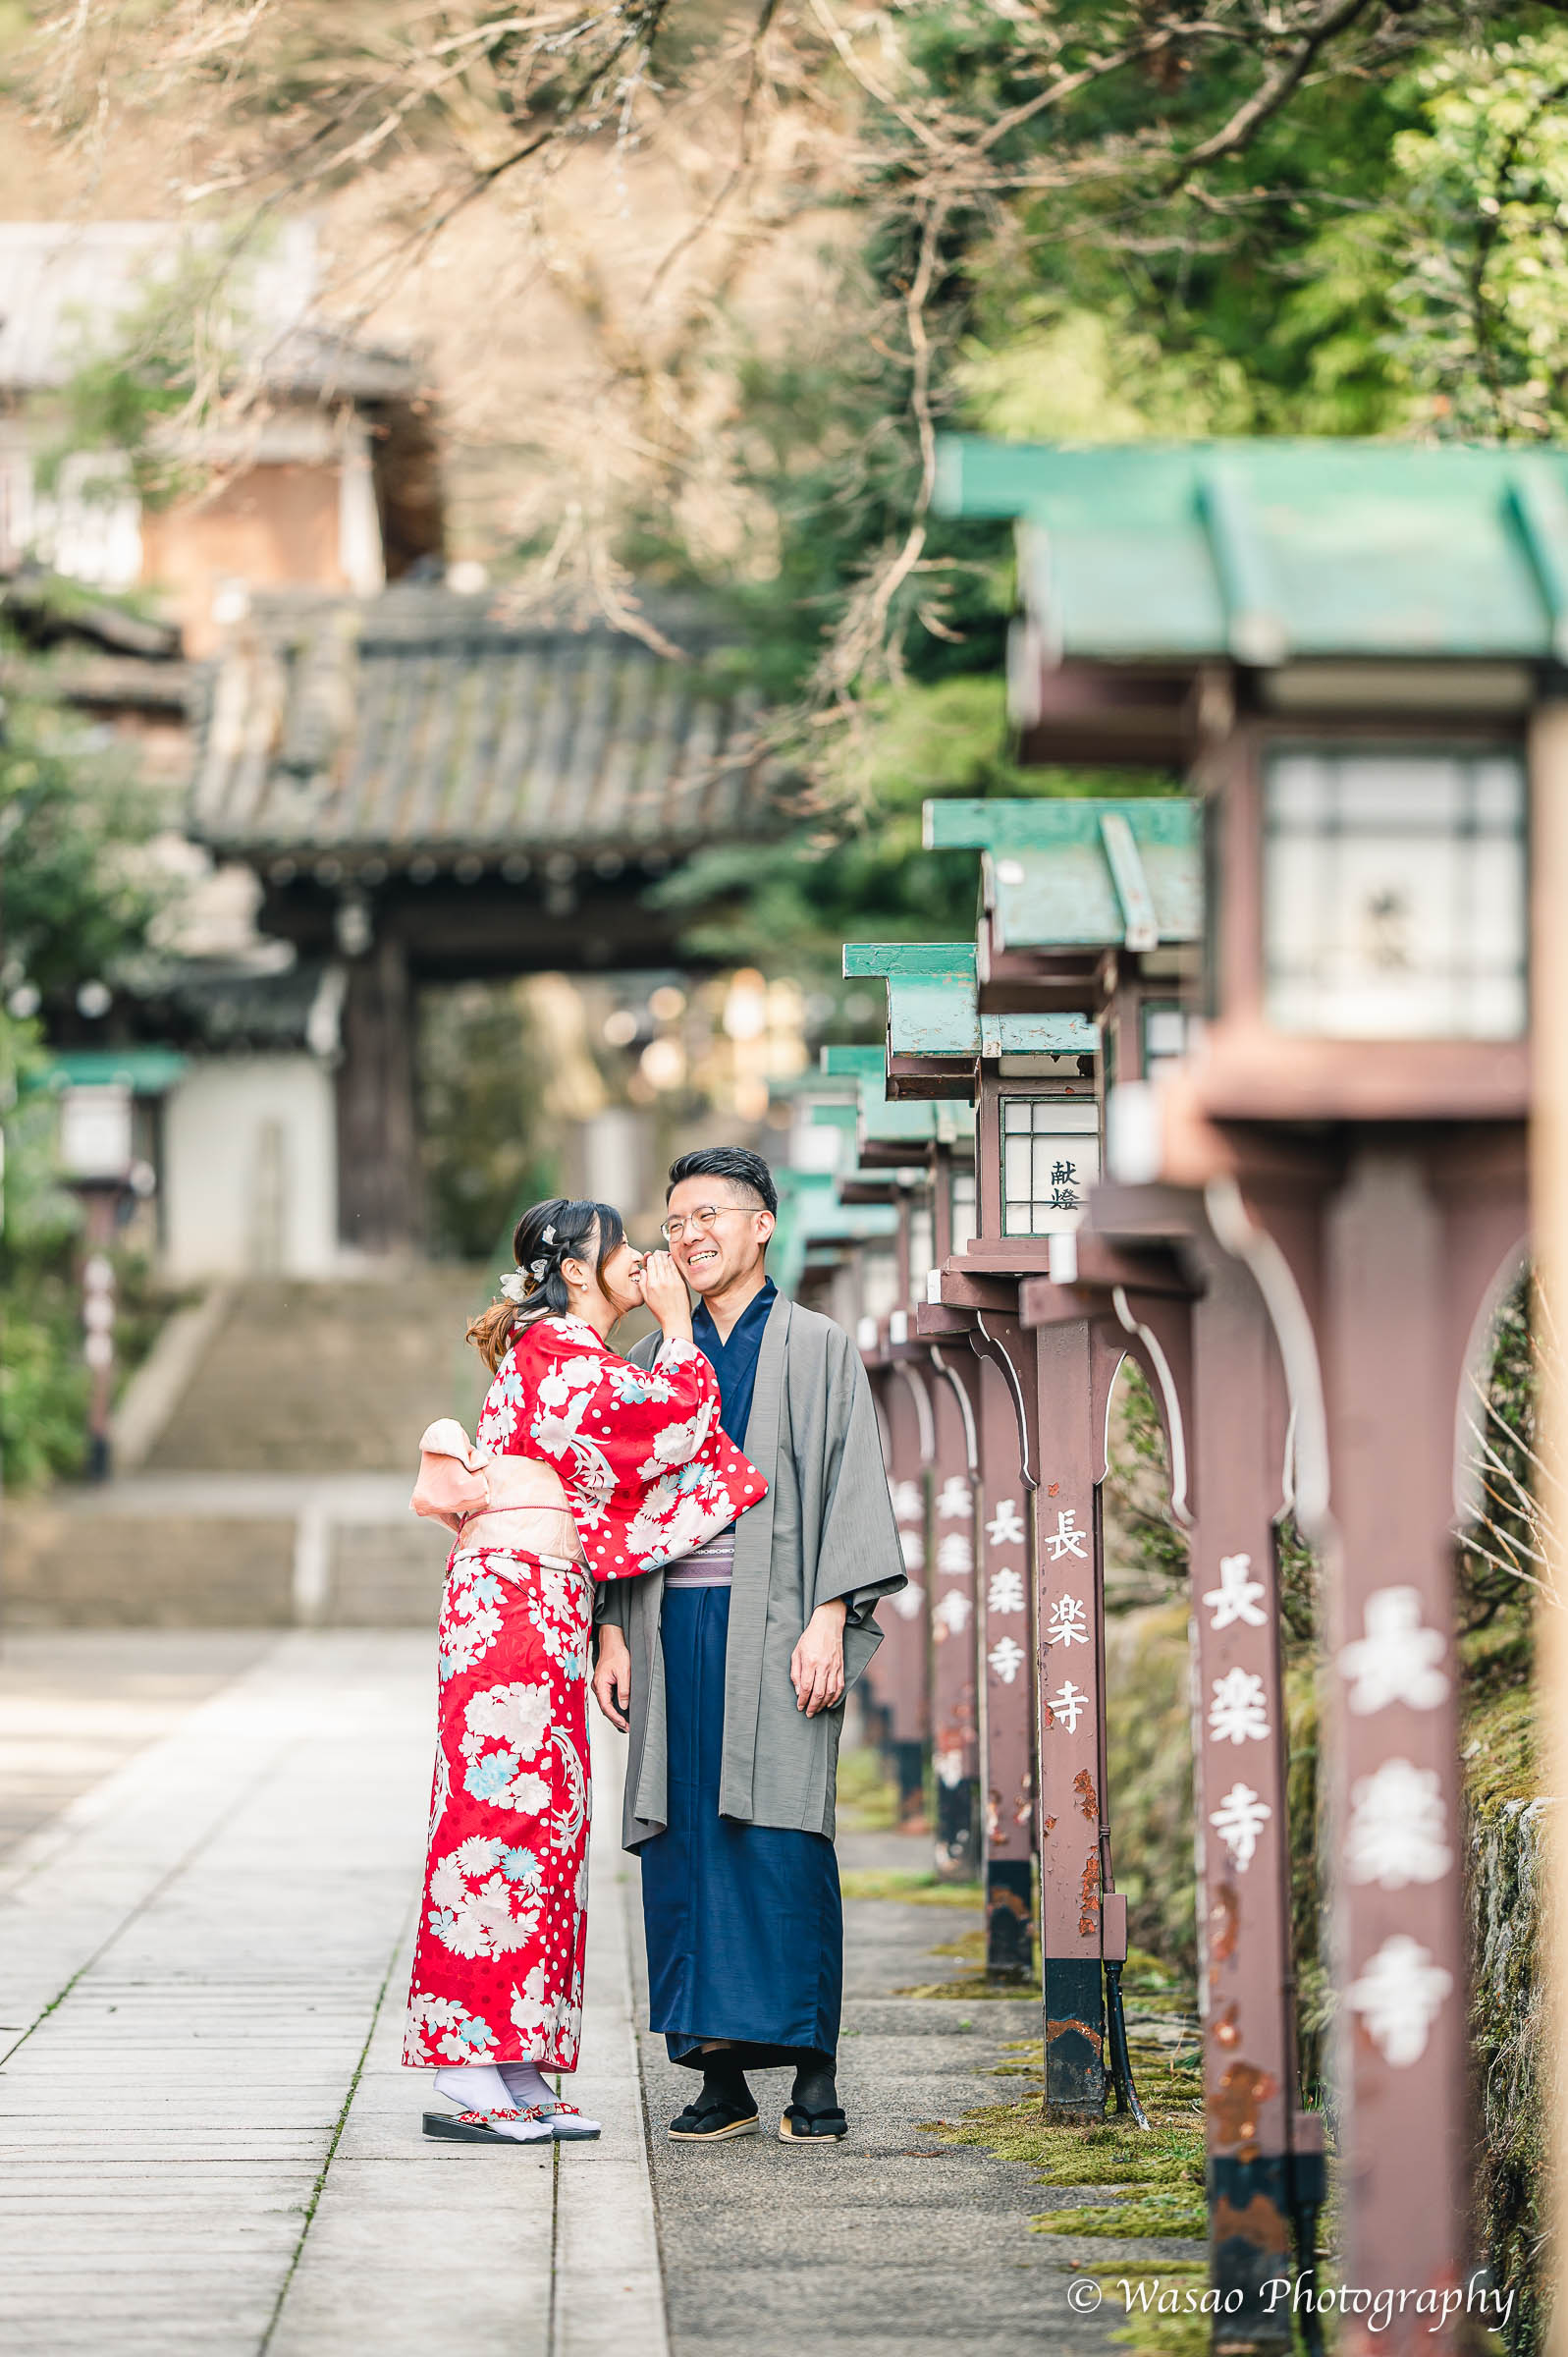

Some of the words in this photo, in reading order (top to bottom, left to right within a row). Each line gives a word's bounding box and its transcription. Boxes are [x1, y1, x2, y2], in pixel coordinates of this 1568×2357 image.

[1051, 1161, 1080, 1210] 献燈
[1045, 1509, 1090, 1734] 長楽寺
[1203, 1553, 1271, 1873] 長楽寺
